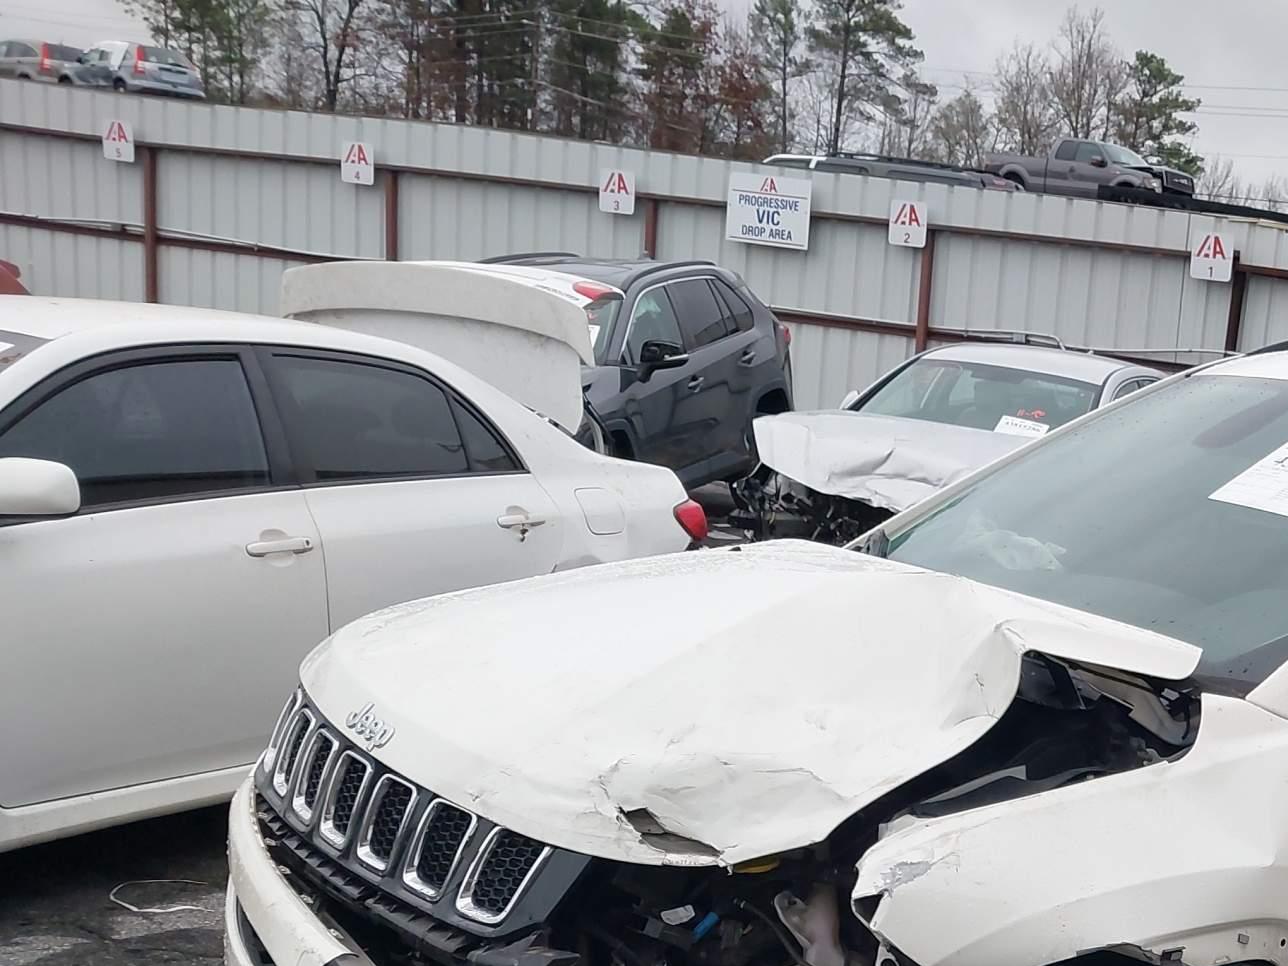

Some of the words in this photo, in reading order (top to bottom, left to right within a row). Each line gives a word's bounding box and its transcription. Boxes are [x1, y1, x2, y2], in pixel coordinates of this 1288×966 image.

[354, 170, 361, 180] 4
[613, 200, 620, 211] 3
[738, 193, 800, 212] PROGRESSIVE
[756, 208, 781, 226] VIC
[741, 224, 766, 237] DROP
[767, 228, 793, 241] AREA
[903, 232, 911, 243] 2
[1208, 266, 1213, 278] 1
[346, 702, 395, 752] Jeep
